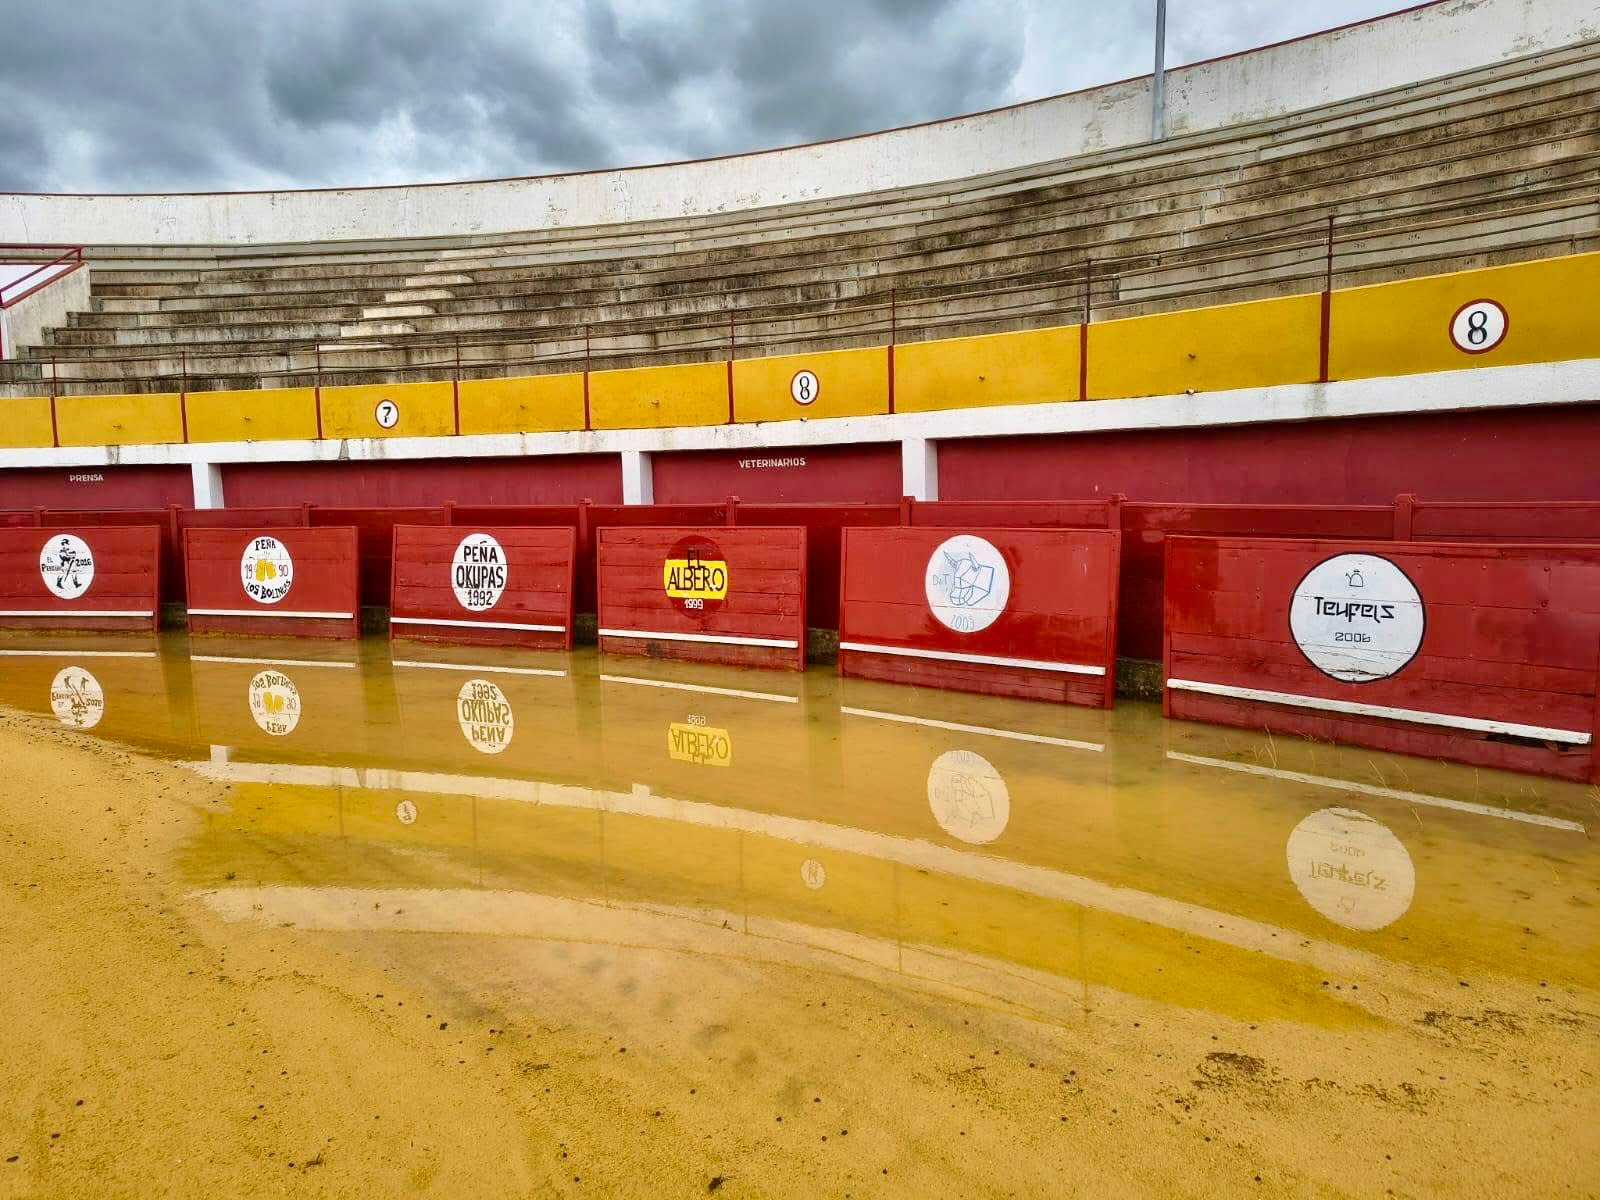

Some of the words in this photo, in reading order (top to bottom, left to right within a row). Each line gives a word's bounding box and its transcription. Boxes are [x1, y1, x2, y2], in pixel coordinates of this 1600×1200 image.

[1467, 310, 1488, 345] 8
[799, 375, 810, 400] 8
[382, 406, 392, 423] 7
[738, 457, 806, 469] VETERINARIOS
[69, 474, 104, 482] PRENSA
[463, 540, 499, 563] PEÑA
[456, 565, 504, 589] OKUPAS
[667, 566, 725, 592] ALBERO
[467, 589, 494, 607] 1992
[684, 598, 704, 610] 1999
[1334, 631, 1372, 643] 2006
